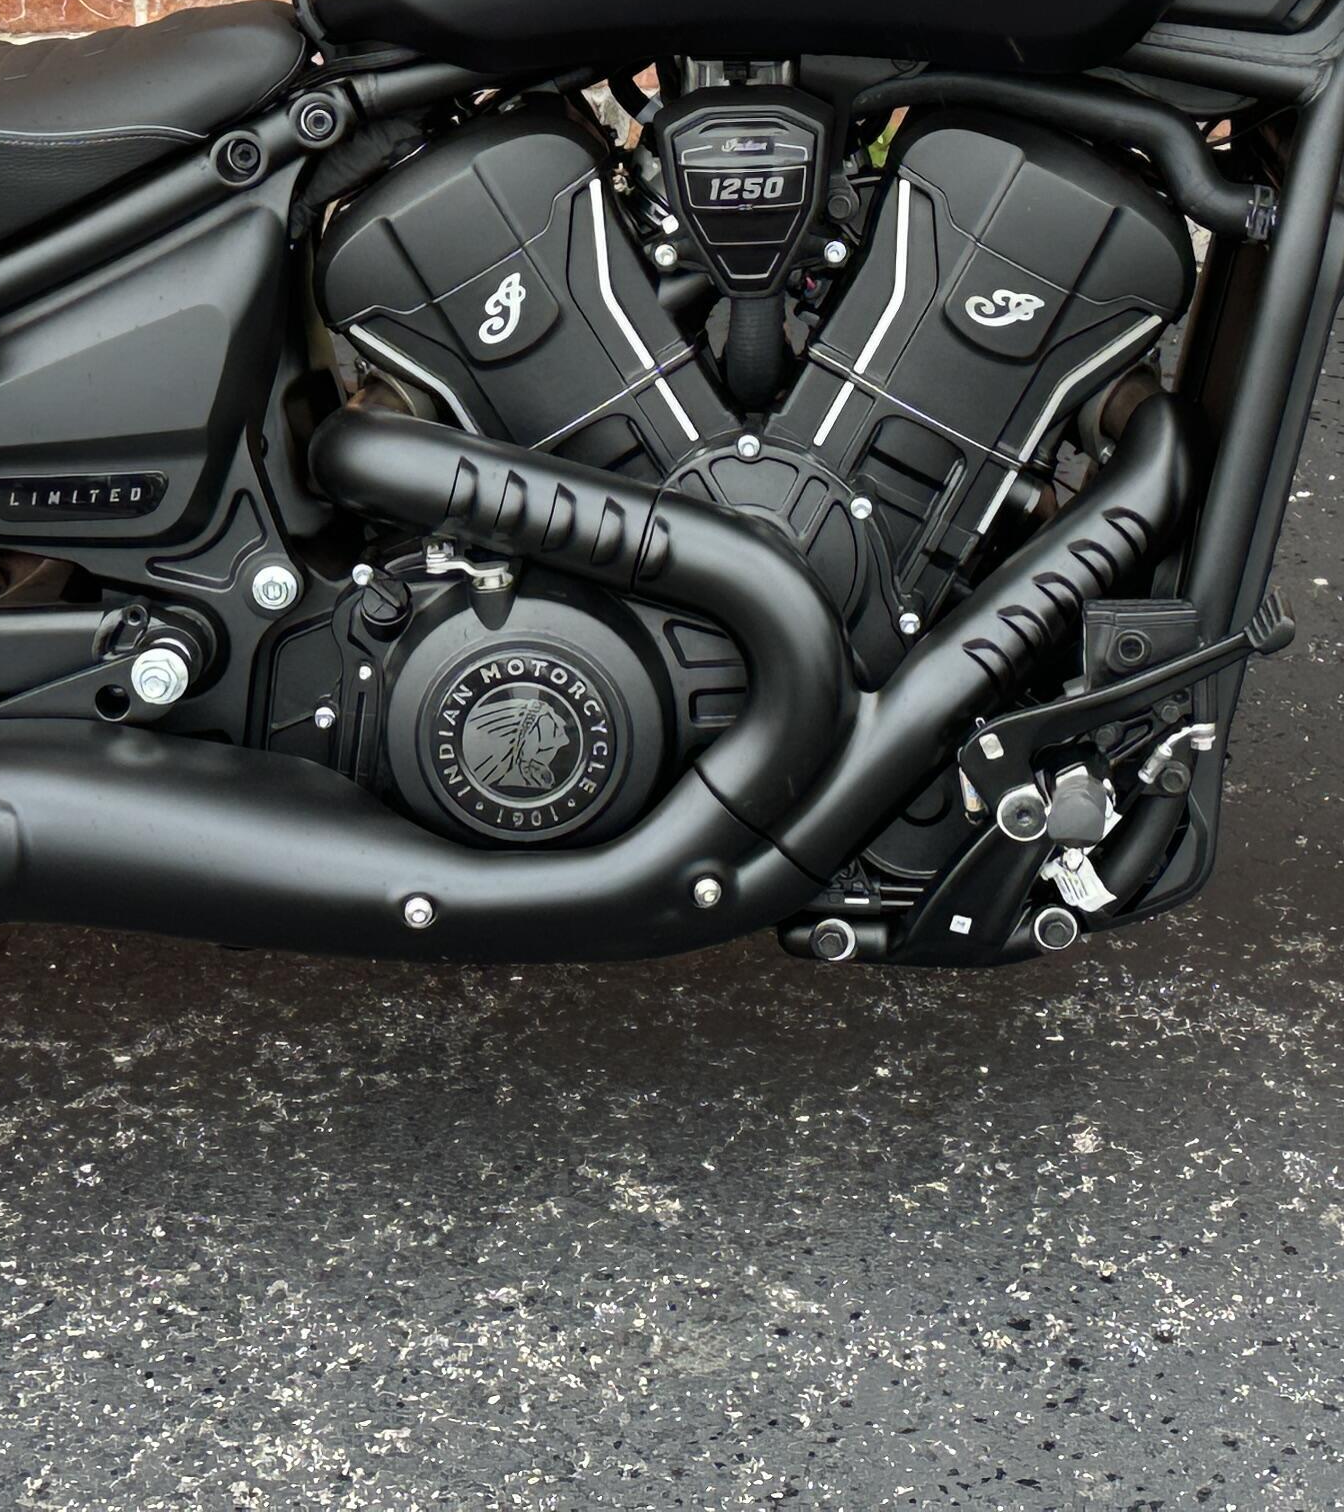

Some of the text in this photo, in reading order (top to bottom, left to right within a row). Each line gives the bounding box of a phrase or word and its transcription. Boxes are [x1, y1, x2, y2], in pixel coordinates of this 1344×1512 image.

[709, 176, 785, 201] 1250
[9, 487, 142, 507] LIMITED
[438, 657, 609, 798] INDIAN MOTORCYCLE
[496, 804, 561, 827] 1901
